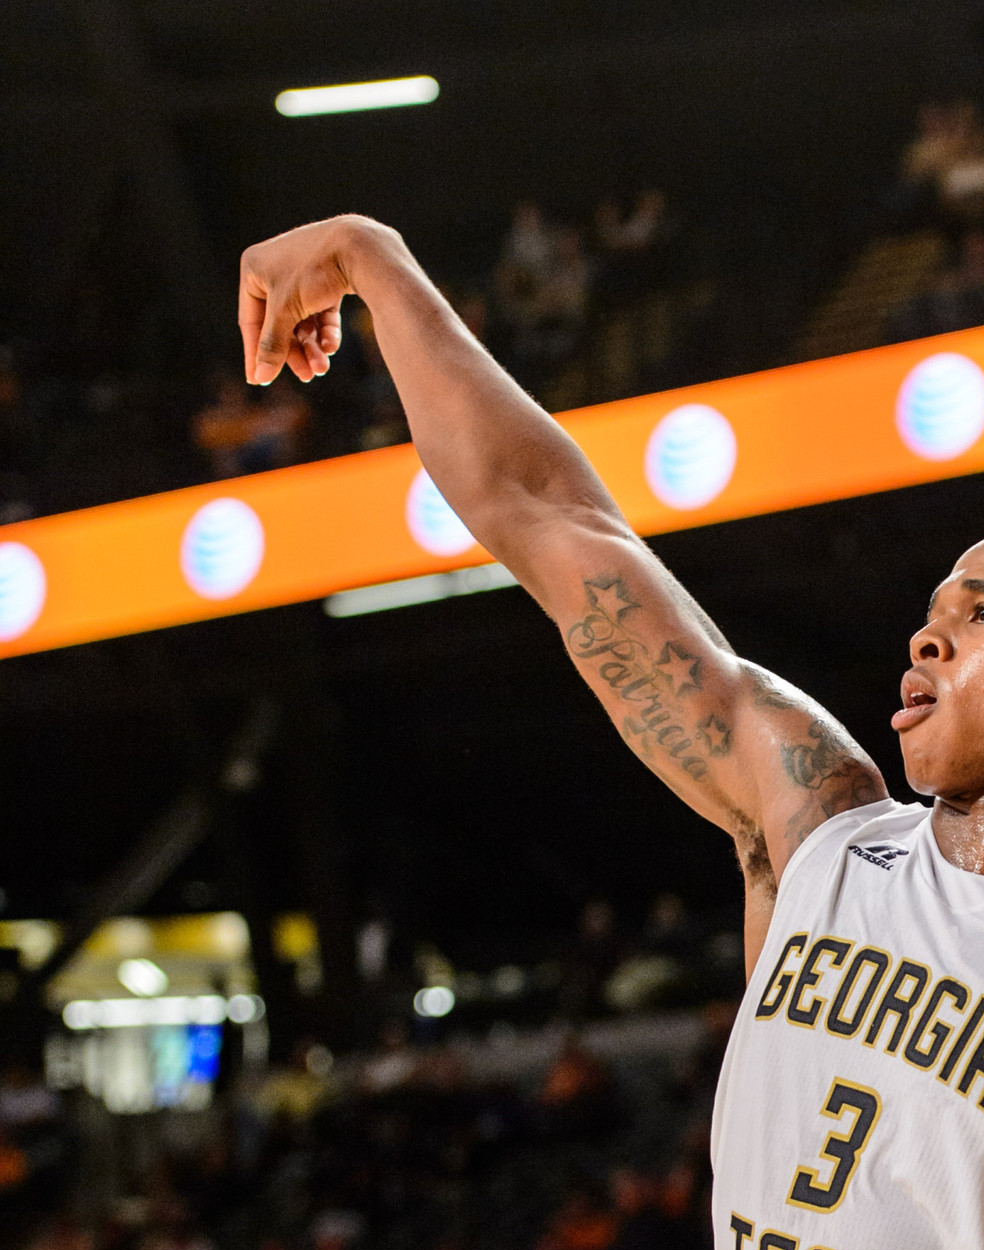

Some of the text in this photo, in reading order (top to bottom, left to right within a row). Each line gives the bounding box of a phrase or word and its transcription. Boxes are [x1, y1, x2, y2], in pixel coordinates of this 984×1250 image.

[567, 611, 708, 783] Patricia
[848, 845, 894, 871] RUSSELL
[786, 1076, 882, 1215] 3
